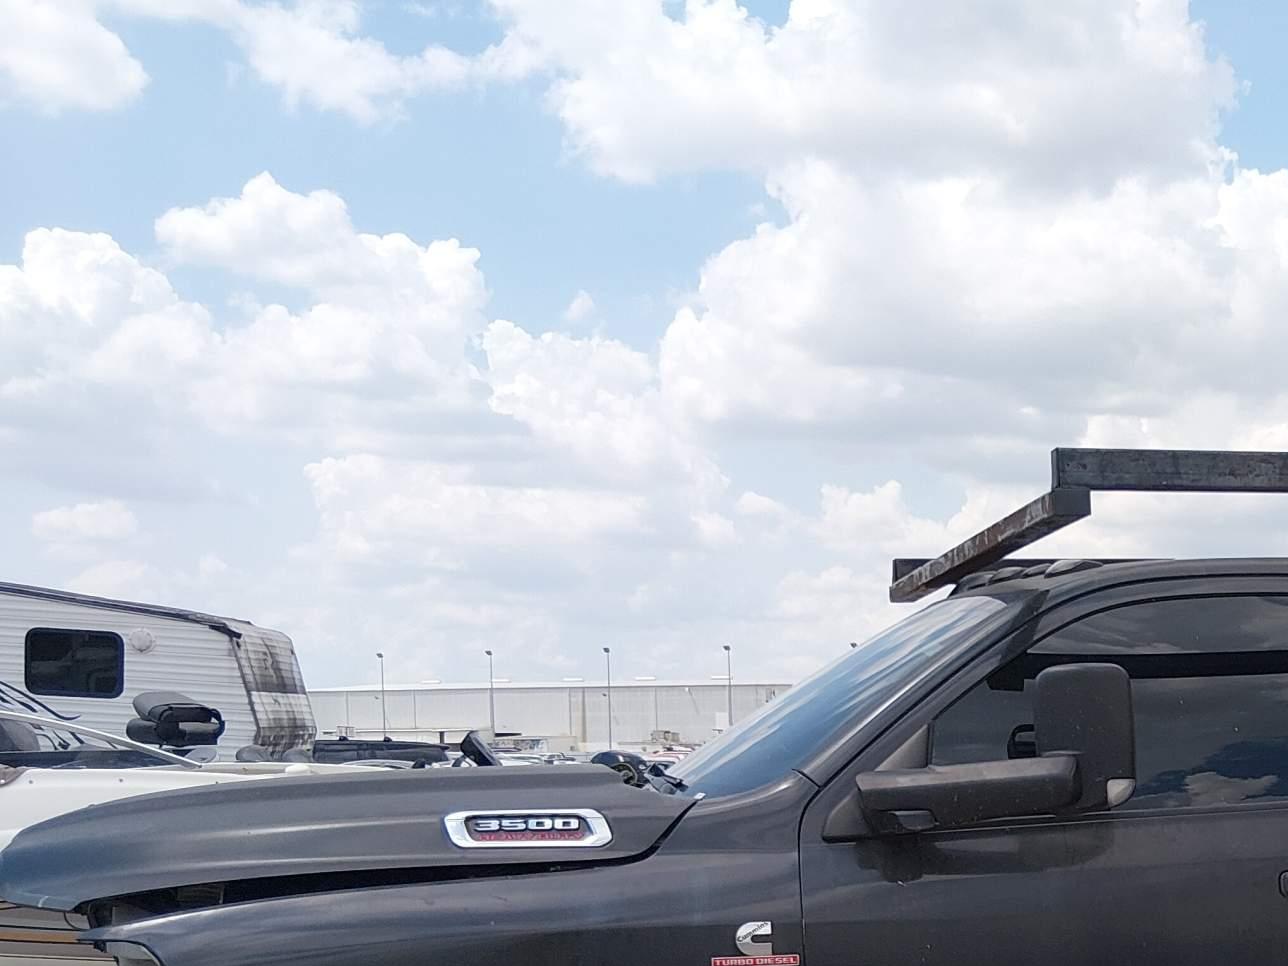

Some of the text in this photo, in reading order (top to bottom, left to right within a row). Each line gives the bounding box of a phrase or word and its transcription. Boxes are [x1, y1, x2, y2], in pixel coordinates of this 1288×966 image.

[474, 818, 579, 831] 3500
[715, 957, 797, 966] TURBO DIESEL
